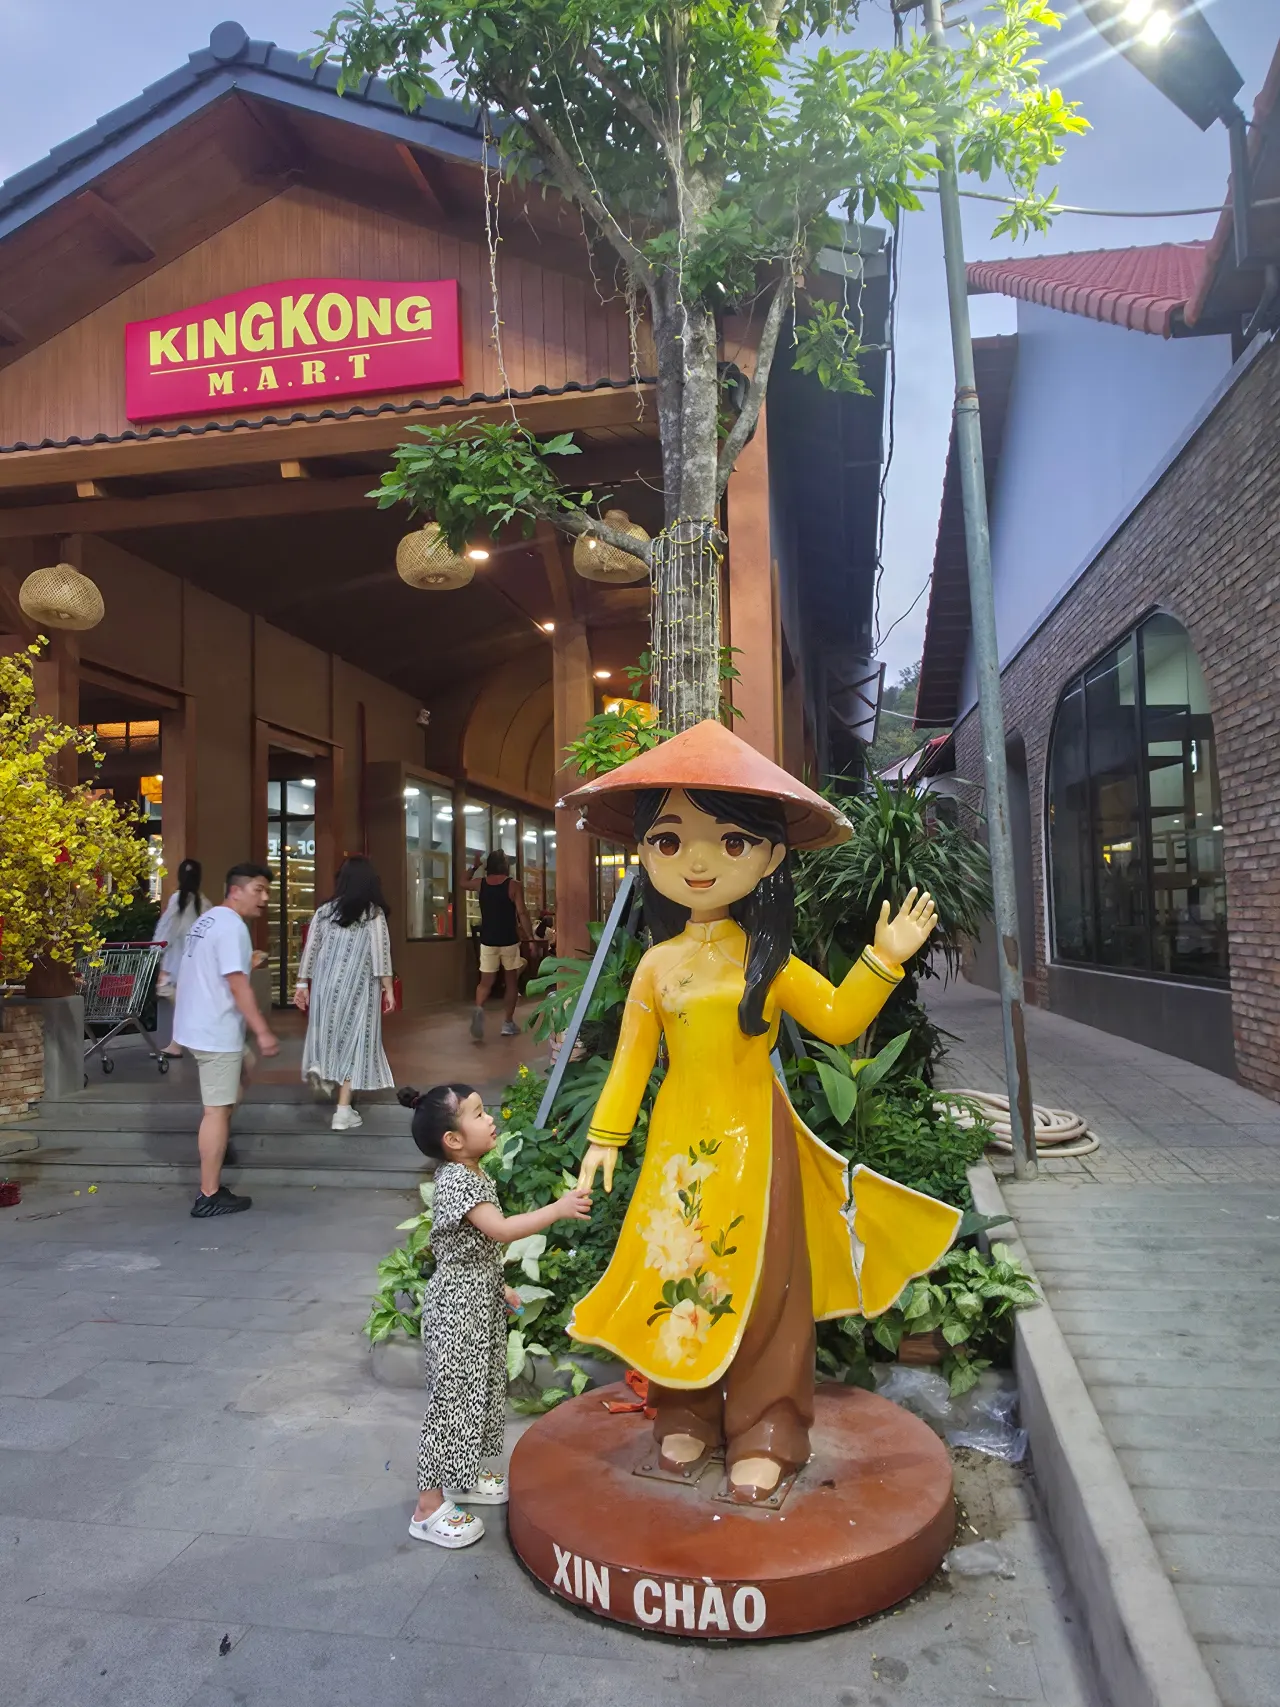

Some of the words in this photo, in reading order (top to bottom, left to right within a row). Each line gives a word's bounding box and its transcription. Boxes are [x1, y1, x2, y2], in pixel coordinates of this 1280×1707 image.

[149, 292, 432, 366] KINGKONG
[552, 1543, 610, 1610] XIN
[633, 1577, 767, 1633] CHÀO
